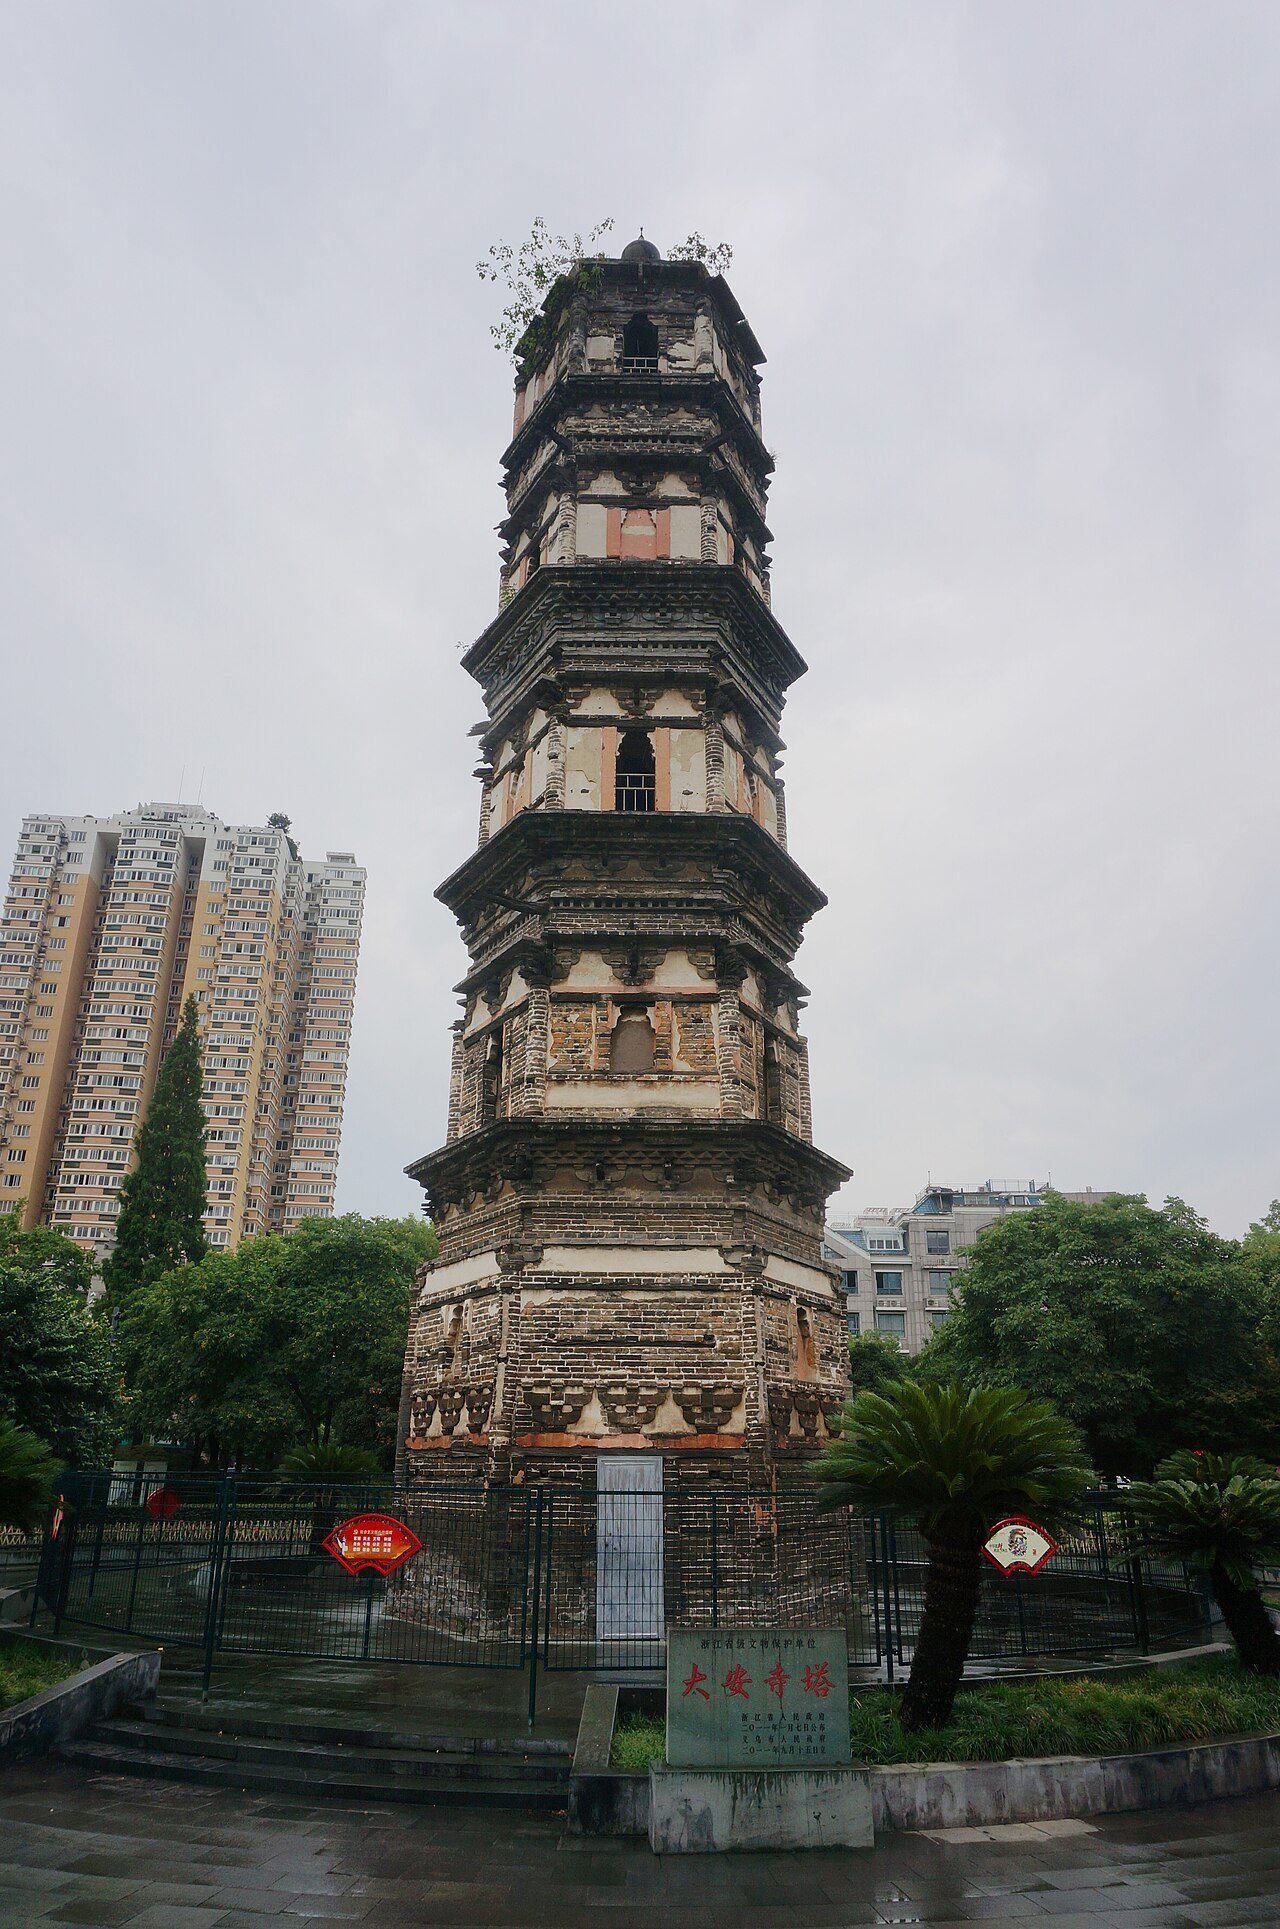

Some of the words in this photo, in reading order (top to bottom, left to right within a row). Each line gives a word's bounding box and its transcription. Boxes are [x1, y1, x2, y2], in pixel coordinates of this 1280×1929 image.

[700, 1638, 816, 1650] 浙江省级文物保护单位
[682, 1661, 835, 1701] 大安寺塔
[741, 1712, 826, 1722] 浙江省人民政府
[742, 1734, 827, 1744] 义乌市人民政府
